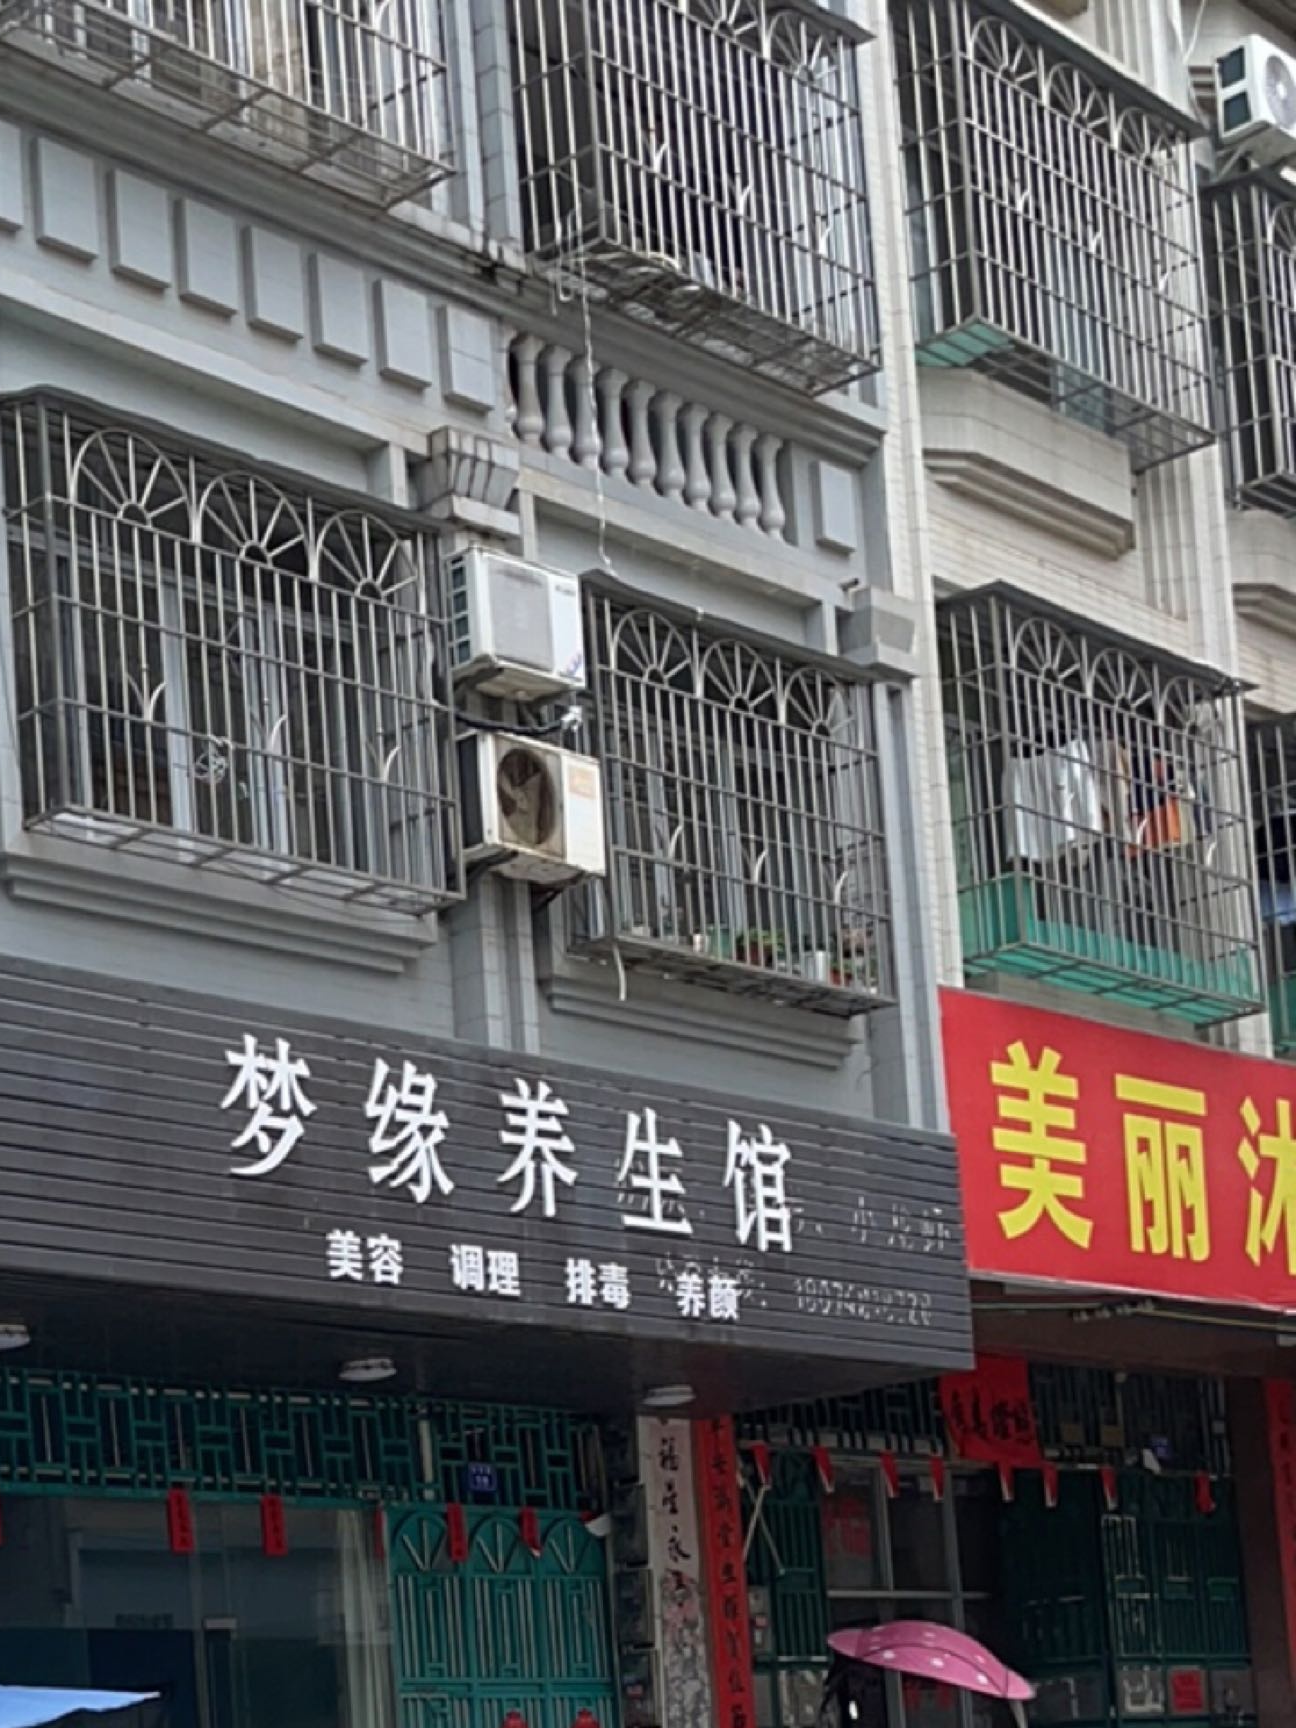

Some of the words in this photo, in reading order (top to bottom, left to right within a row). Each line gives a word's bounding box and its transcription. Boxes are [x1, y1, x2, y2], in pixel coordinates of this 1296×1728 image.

[220, 1034, 794, 1254] 梦缘养生馆
[324, 1229, 405, 1286] 美容
[449, 1243, 521, 1298] 调理
[564, 1257, 632, 1312] 排毒
[676, 1272, 741, 1322] 养颜
